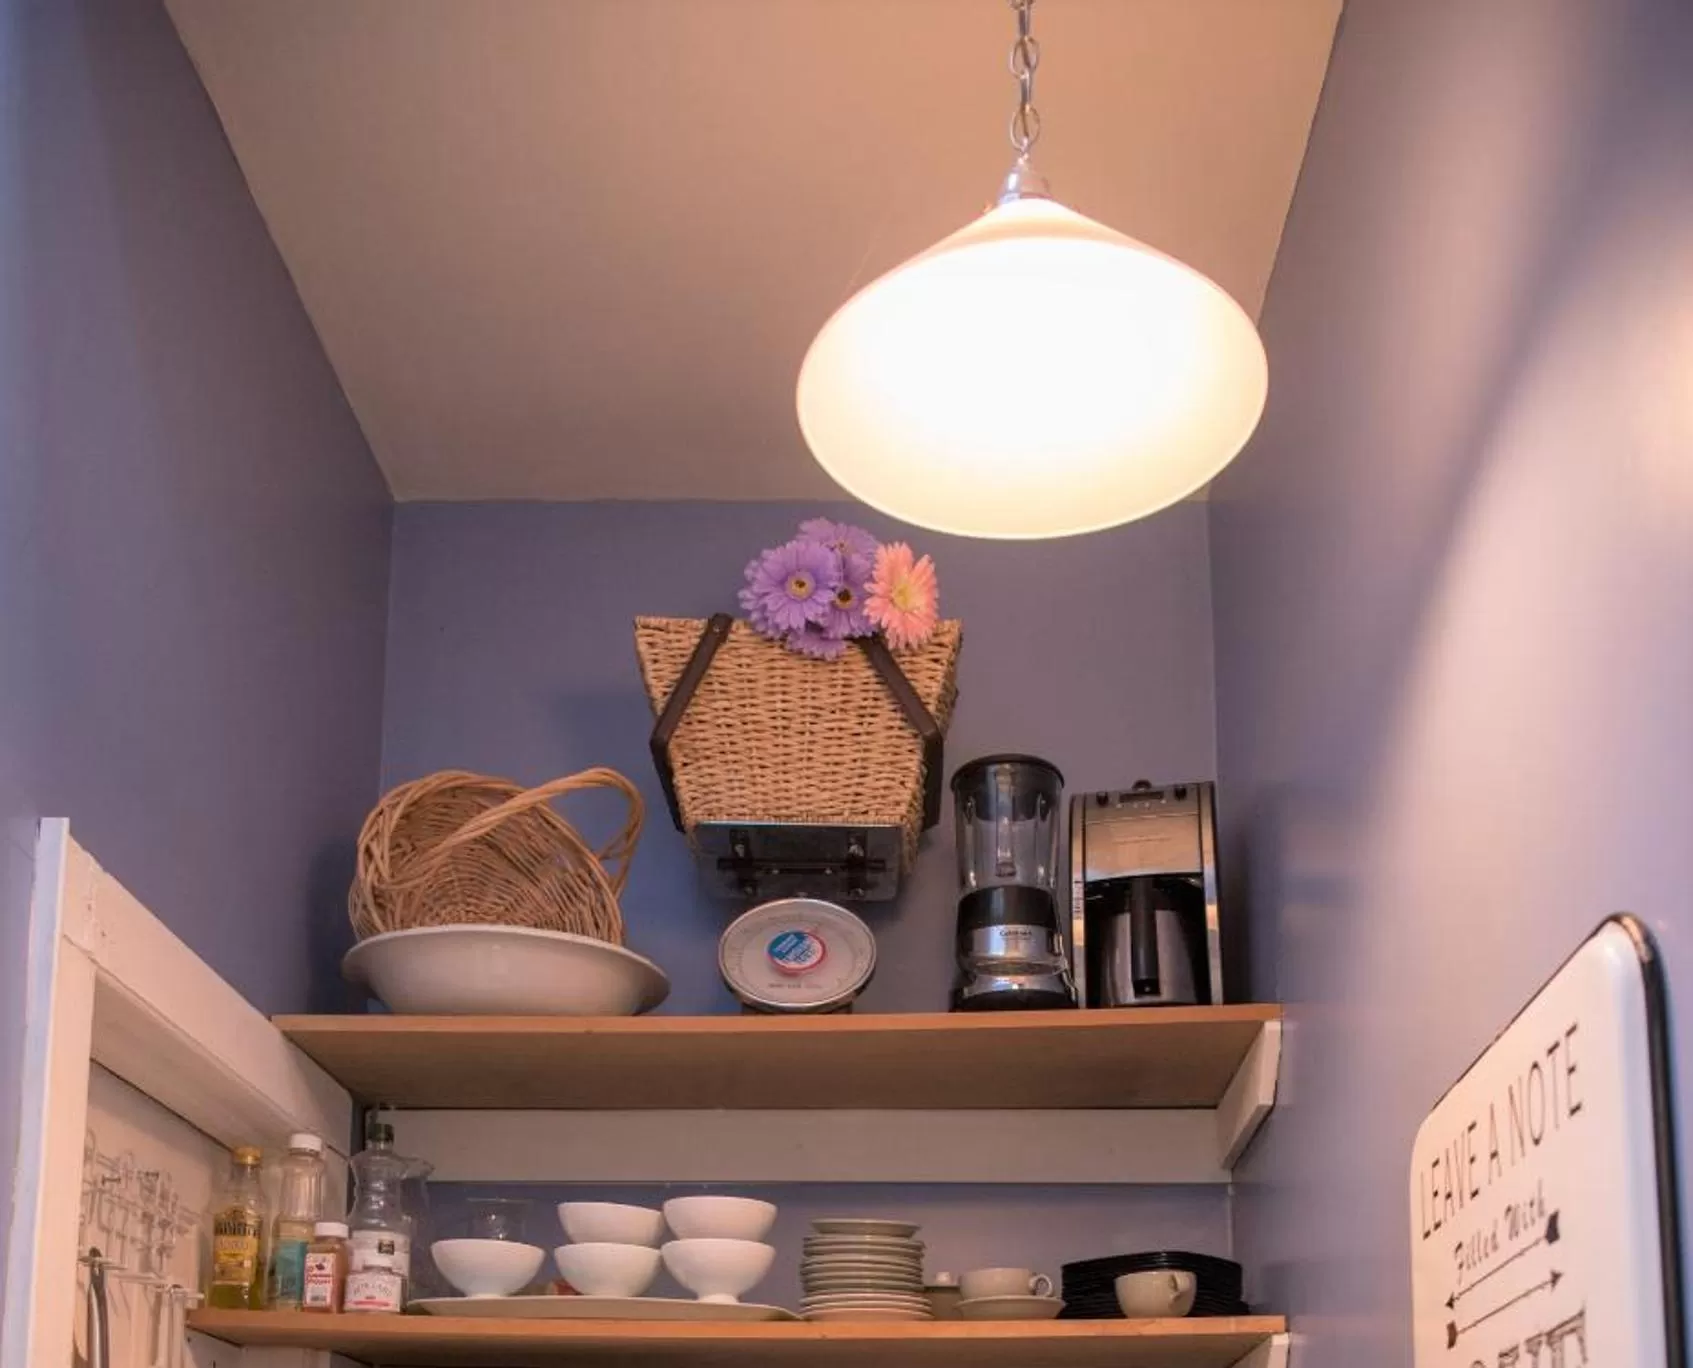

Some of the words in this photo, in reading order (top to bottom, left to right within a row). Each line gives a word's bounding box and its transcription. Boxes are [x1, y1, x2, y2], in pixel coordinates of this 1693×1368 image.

[1420, 1121, 1479, 1240] LEAVE
[1487, 1102, 1503, 1186] A
[1508, 1023, 1582, 1167] NOTE
[1455, 1218, 1500, 1285] Filled
[1504, 1177, 1546, 1241] With
